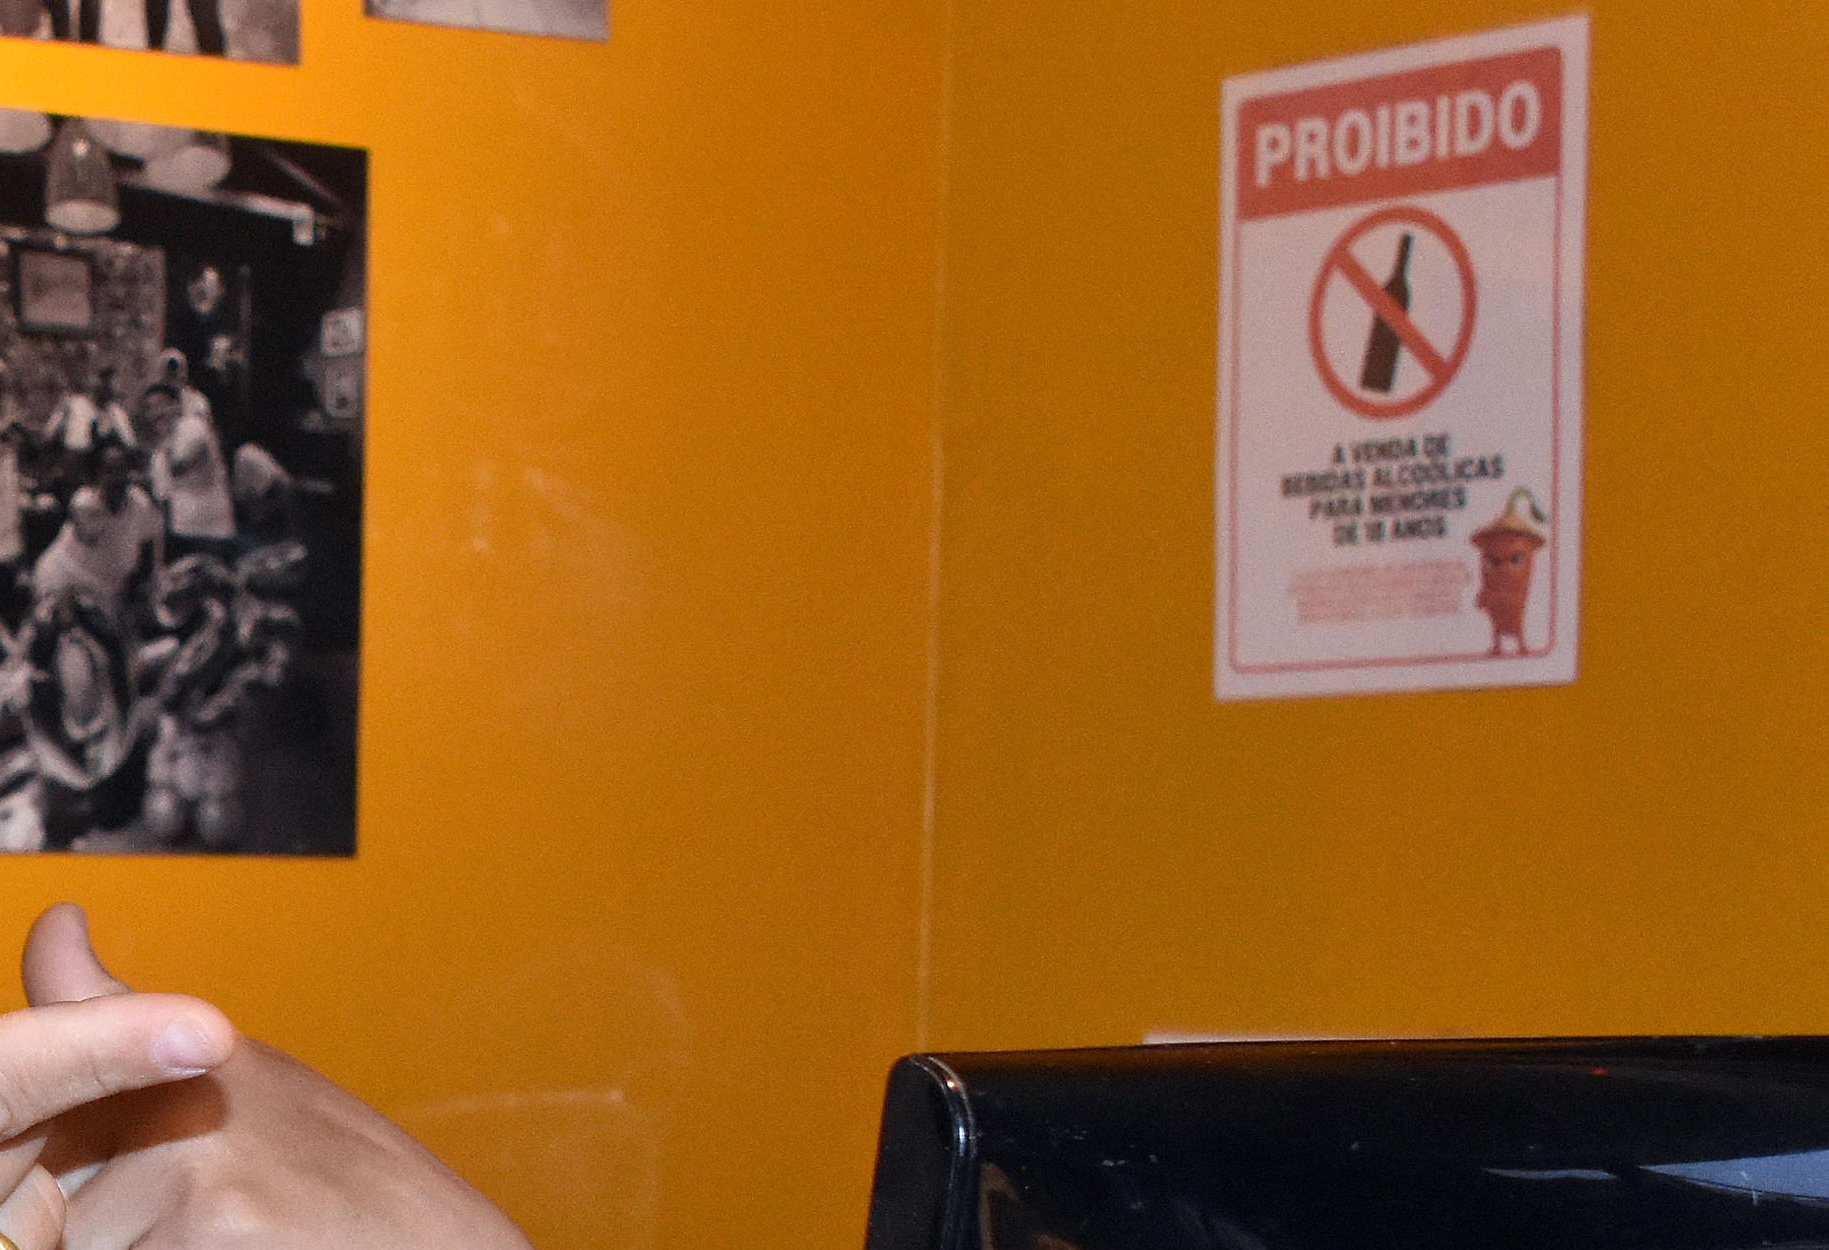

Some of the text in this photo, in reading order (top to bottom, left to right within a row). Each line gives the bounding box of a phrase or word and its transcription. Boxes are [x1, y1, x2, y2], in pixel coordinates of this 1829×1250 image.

[1255, 79, 1541, 188] PROIBIDO
[1350, 438, 1417, 463] VENDA
[1422, 433, 1449, 458] DE
[1281, 469, 1366, 498] BEBIDAS
[1309, 486, 1469, 519] PARA MENORES
[1333, 522, 1360, 546] DE
[1391, 516, 1448, 541] ANOS
